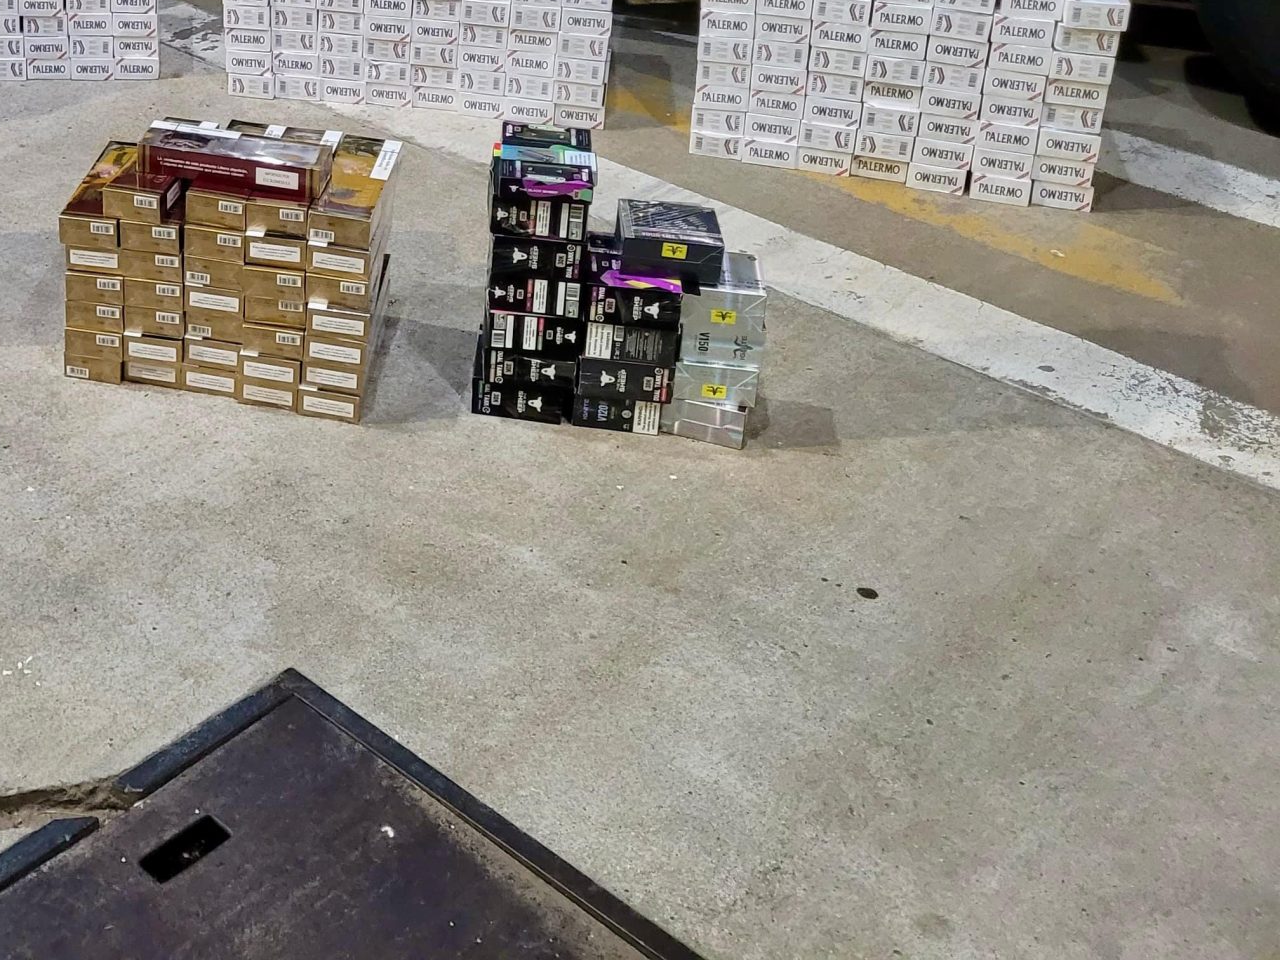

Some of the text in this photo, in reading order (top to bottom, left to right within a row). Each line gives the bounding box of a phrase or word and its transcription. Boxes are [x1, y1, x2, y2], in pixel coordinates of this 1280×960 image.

[24, 1, 57, 10] PALERMO
[370, 0, 406, 11] PALERMO
[118, 21, 151, 30] PALERMO
[567, 16, 605, 28] PALERMO
[707, 19, 748, 31] PALERMO
[880, 12, 923, 26] PALERMO
[417, 26, 453, 38] PALERMO
[1000, 25, 1045, 39] PALERMO
[119, 41, 152, 50] PALERMO
[515, 34, 551, 46] PALERMO
[875, 38, 918, 52] PALERMO
[29, 44, 63, 52] PALERMO
[935, 44, 979, 59] PALERMO
[33, 65, 66, 74] PALERMO
[120, 65, 153, 74] PALERMO
[278, 59, 312, 70] PALERMO
[511, 57, 548, 70] PALERMO
[758, 73, 799, 86] PALERMO
[371, 89, 407, 100] PALERMO
[871, 85, 913, 100] PALERMO
[1053, 85, 1099, 100] PALERMO
[464, 100, 500, 112] PALERMO
[929, 96, 972, 111] PALERMO
[560, 110, 598, 122] PALERMO
[812, 106, 853, 120] PALERMO
[989, 104, 1034, 118] PALERMO
[927, 122, 971, 136] PALERMO
[985, 131, 1030, 146] PALERMO
[749, 147, 790, 161] PALERMO
[802, 154, 844, 168] PALERMO
[980, 157, 1025, 172] PALERMO
[1039, 163, 1085, 178] PALERMO
[915, 172, 958, 186] PALERMO
[1040, 188, 1085, 203] PALERMO
[698, 332, 710, 352] V150
[597, 404, 609, 421] V120
